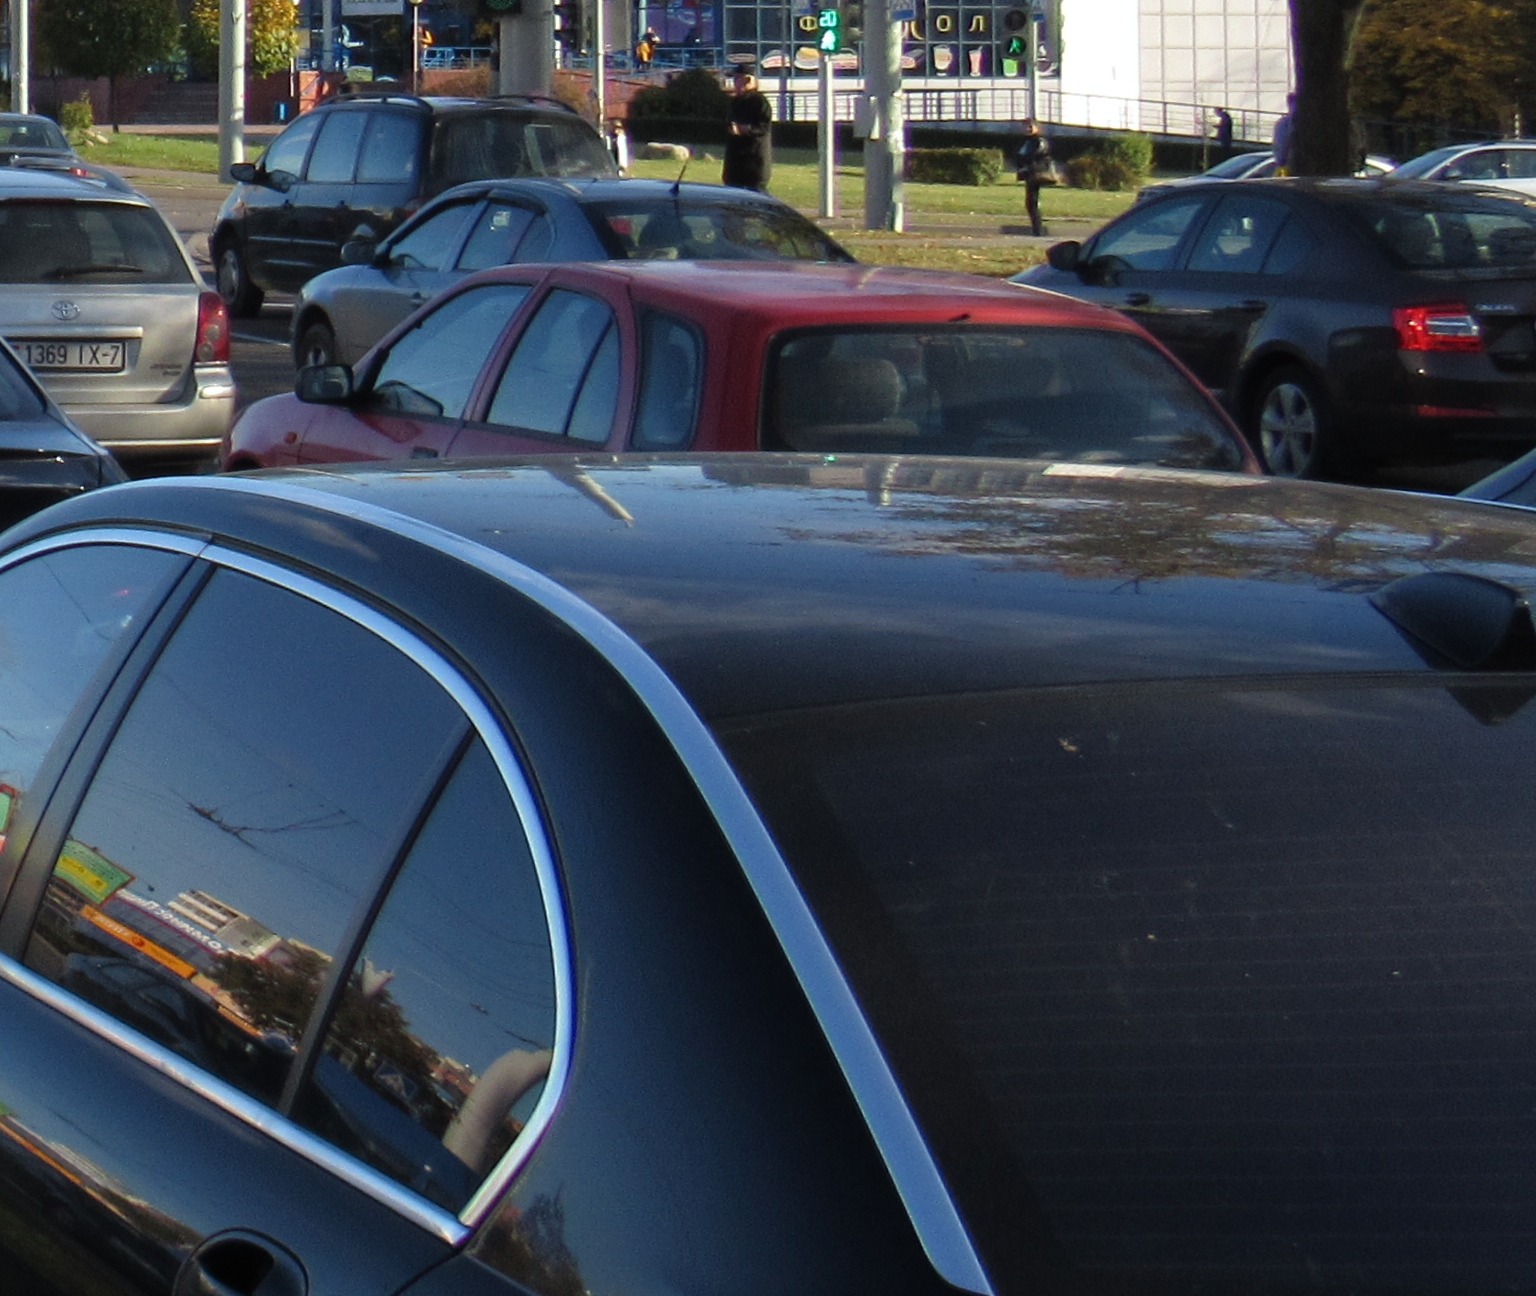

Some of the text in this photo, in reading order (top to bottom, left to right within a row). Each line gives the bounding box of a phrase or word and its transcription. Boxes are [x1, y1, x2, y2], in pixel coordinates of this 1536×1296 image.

[819, 10, 837, 25] 20
[26, 344, 121, 365] 1369 IX-7
